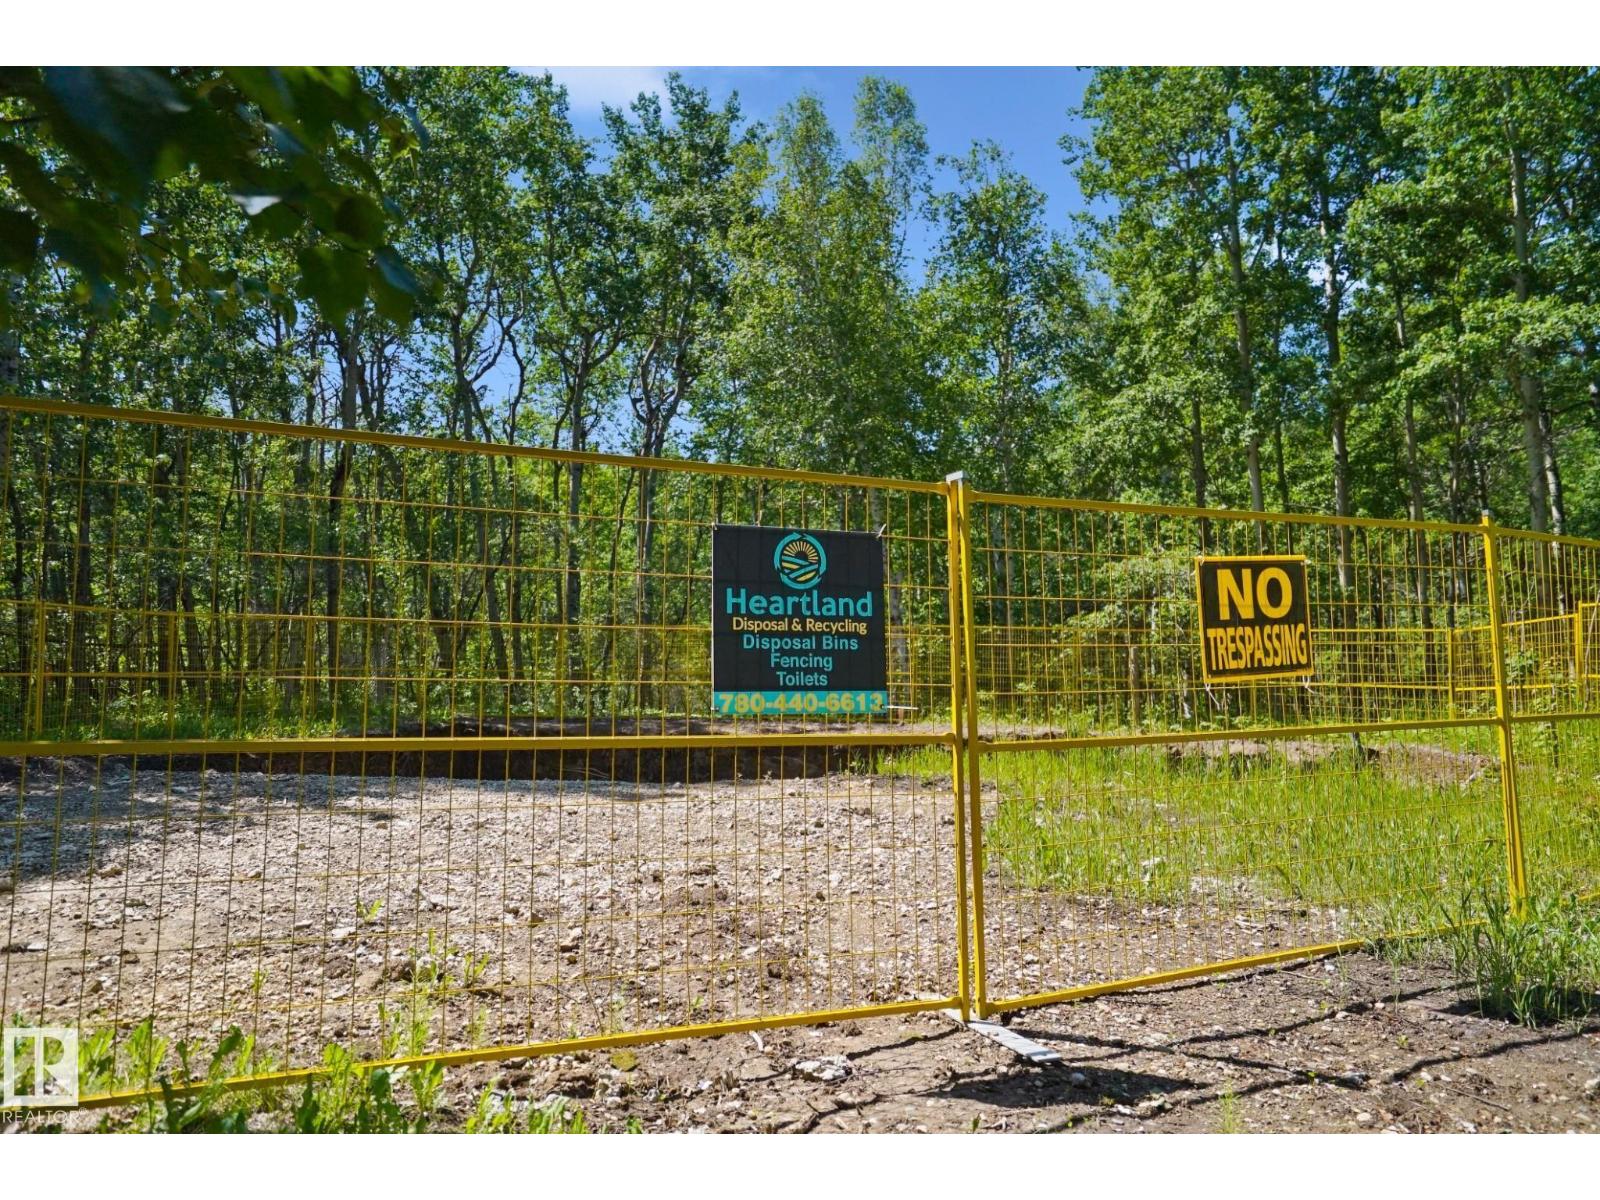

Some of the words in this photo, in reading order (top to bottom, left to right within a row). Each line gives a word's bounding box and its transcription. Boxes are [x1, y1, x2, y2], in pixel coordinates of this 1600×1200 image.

[726, 587, 873, 617] Heartland
[1216, 567, 1293, 620] NO
[732, 617, 788, 632] Disposal
[791, 618, 802, 632] &
[806, 619, 868, 635] Recycling
[742, 634, 816, 652] Disposal
[822, 635, 859, 650] Bins
[1207, 623, 1307, 670] TRESPASSING
[770, 652, 833, 671] Fencing
[776, 671, 828, 686] Toilets
